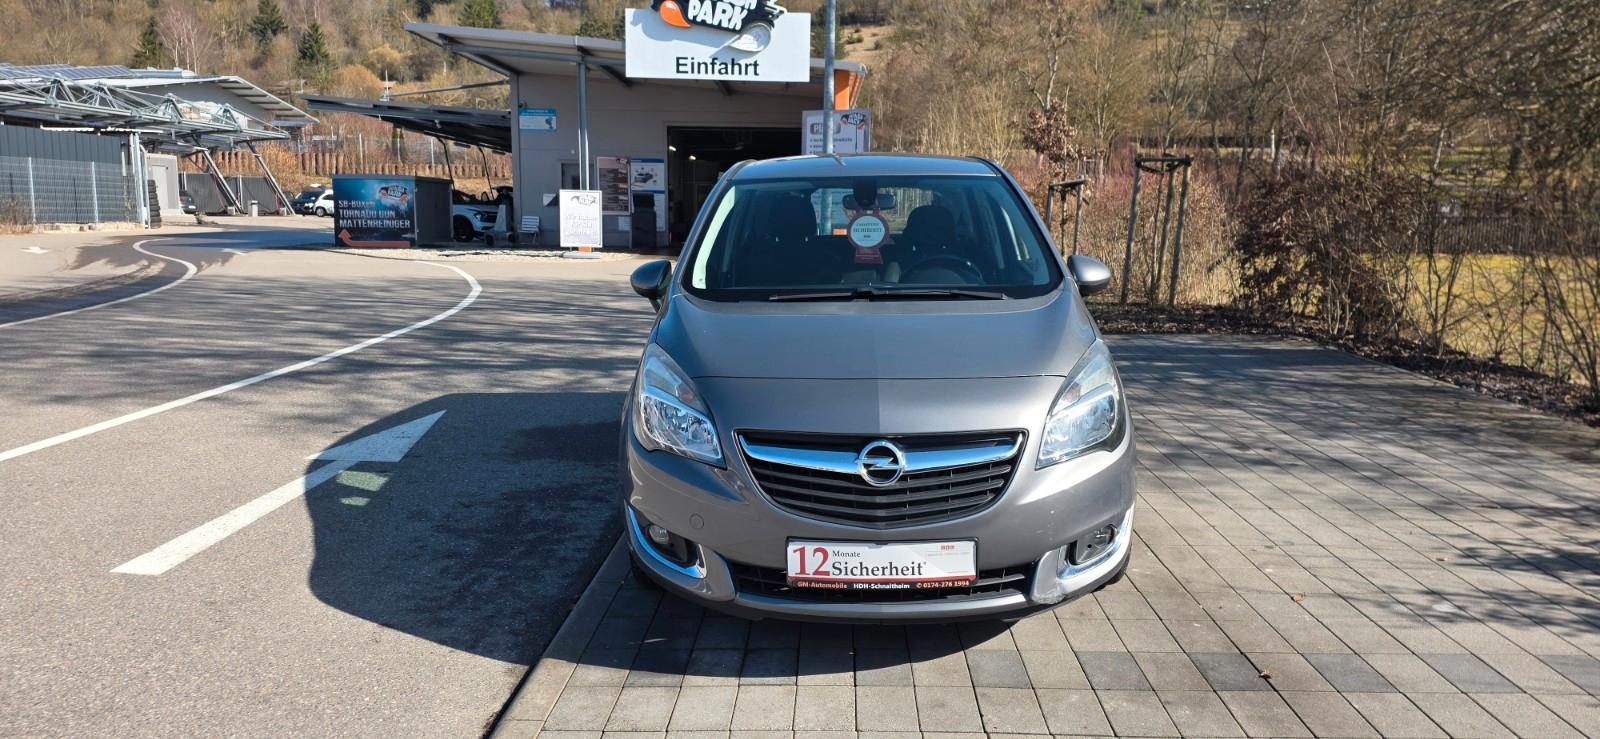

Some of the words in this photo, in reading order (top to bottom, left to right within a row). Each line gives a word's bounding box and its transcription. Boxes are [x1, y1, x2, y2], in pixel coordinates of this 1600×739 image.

[687, 0, 748, 31] PARK
[675, 56, 760, 76] Einfahrt
[339, 209, 377, 219] TORNADO
[339, 219, 410, 229] MATTENREINIGER
[832, 550, 861, 558] Monate
[792, 544, 831, 577] 12
[797, 581, 848, 589] GM-Automobile
